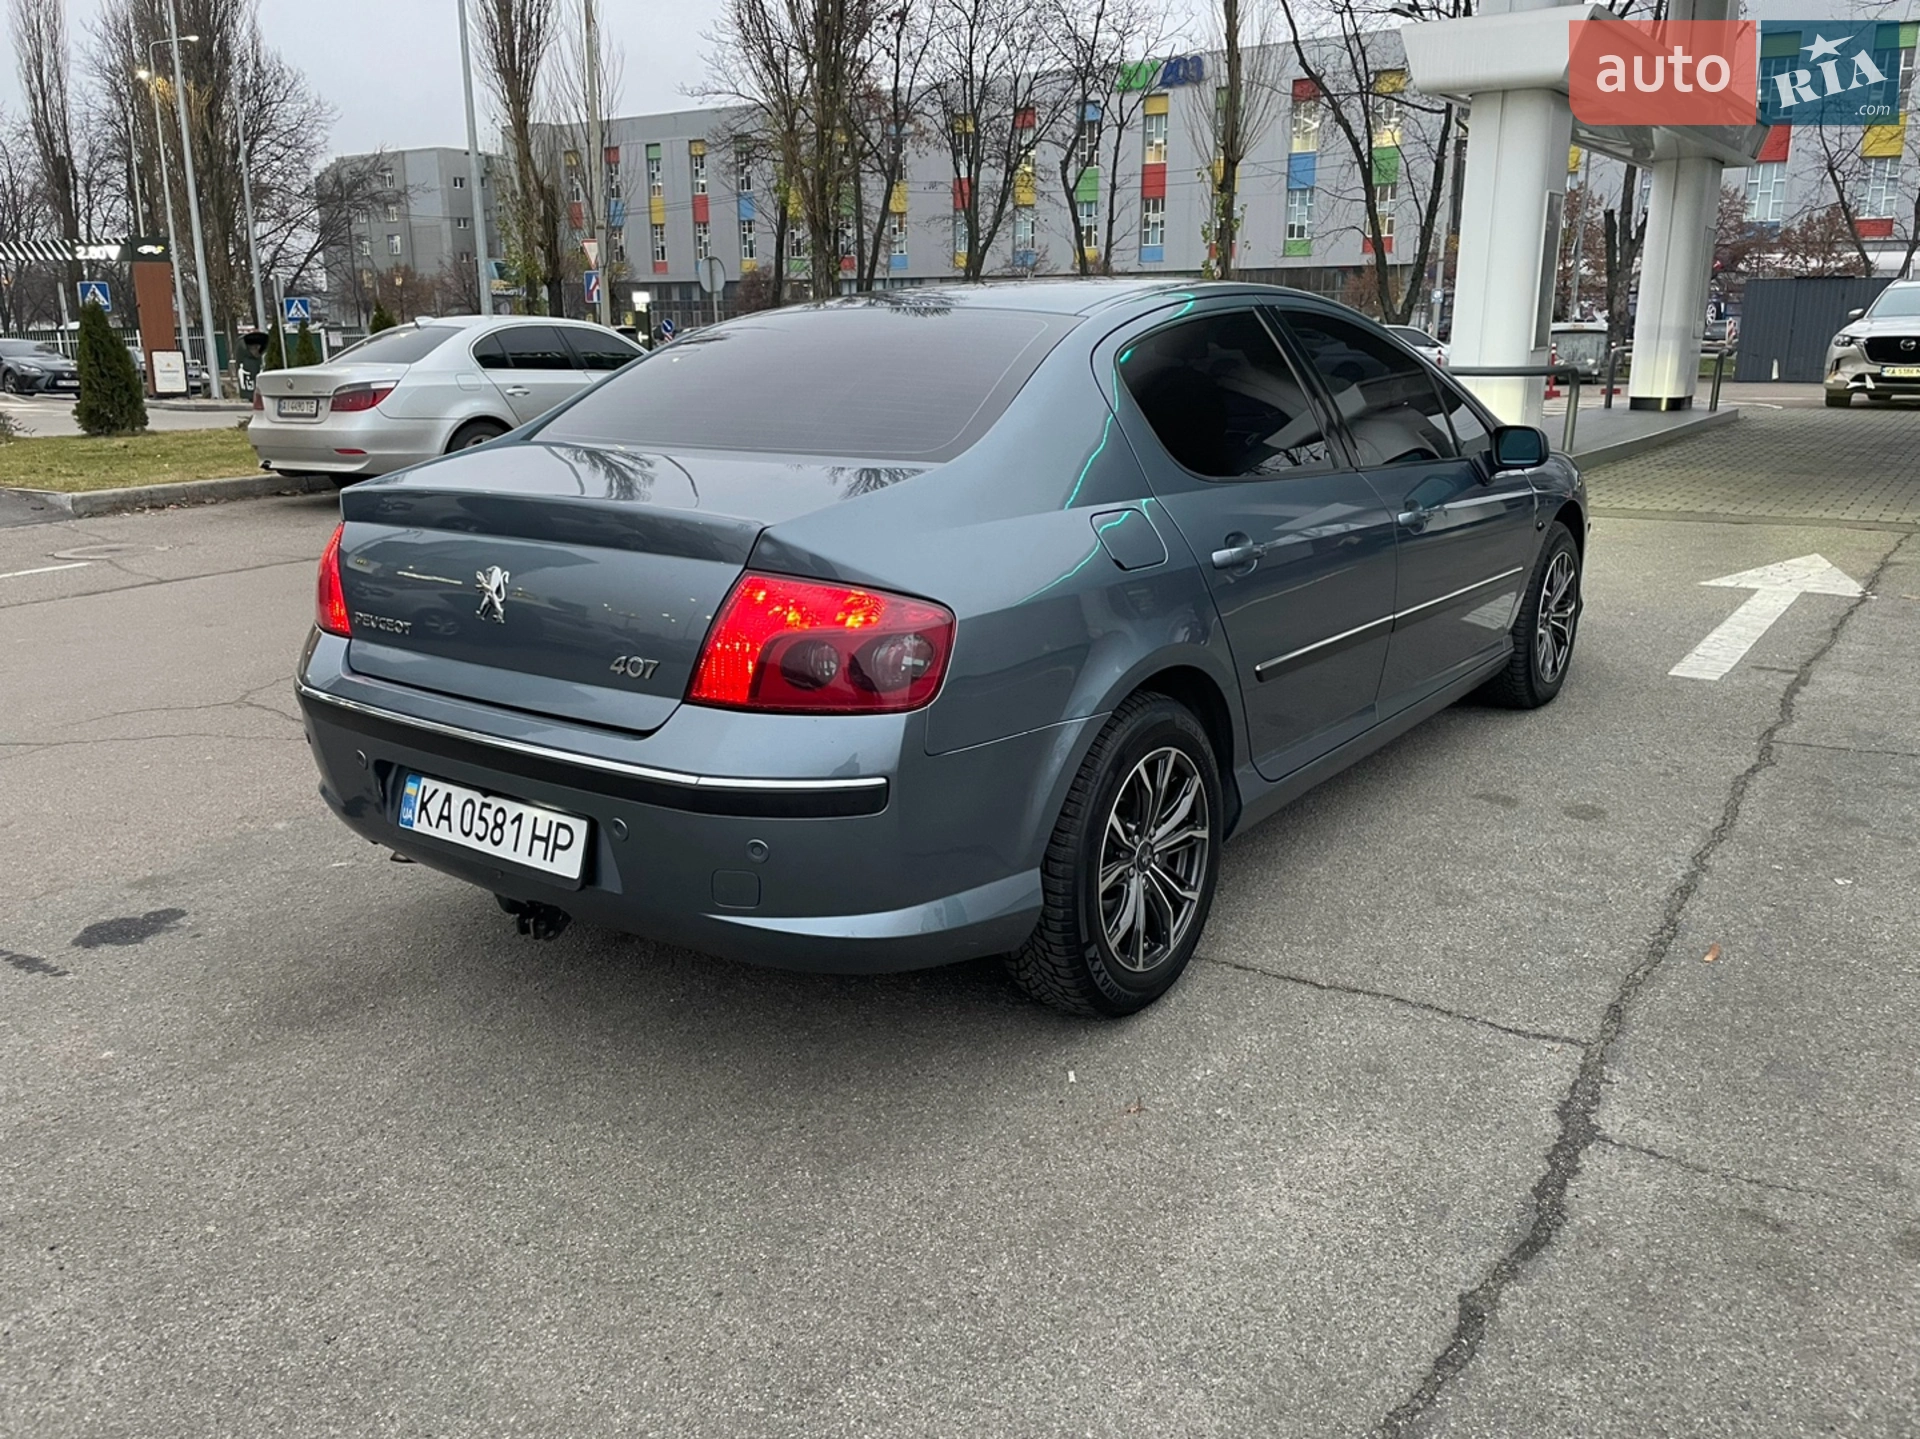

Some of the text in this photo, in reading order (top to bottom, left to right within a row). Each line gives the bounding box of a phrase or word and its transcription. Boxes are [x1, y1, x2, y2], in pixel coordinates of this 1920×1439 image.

[354, 611, 412, 635] PEUGEOT
[609, 655, 660, 679] 407
[402, 808, 413, 820] UA
[417, 785, 575, 863] KA 0581 HP
